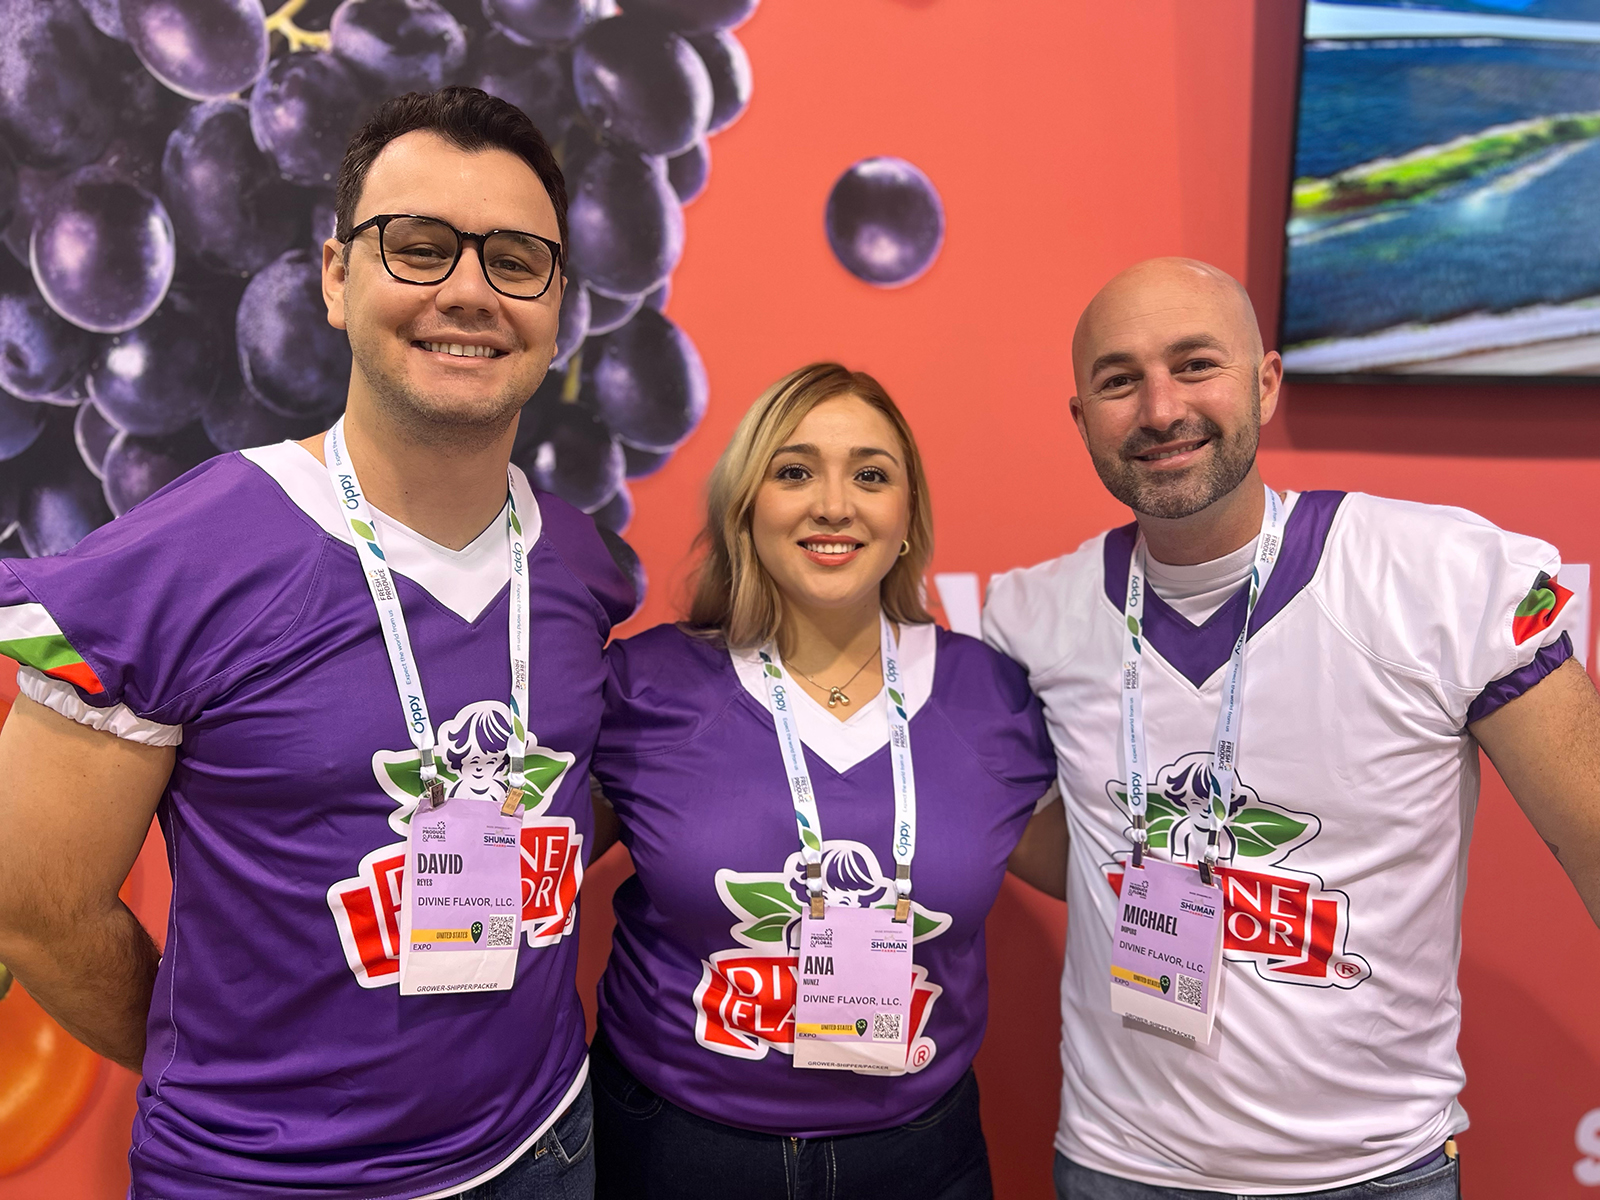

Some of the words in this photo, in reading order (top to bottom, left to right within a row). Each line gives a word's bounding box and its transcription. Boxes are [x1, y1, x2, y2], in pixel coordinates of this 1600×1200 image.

[338, 474, 361, 510] Oppy
[512, 542, 524, 576] Oppy
[1260, 534, 1272, 562] PRODUCE
[374, 578, 386, 601] FRESH
[378, 568, 393, 600] PRODUCE
[1129, 575, 1141, 607] Oppy
[388, 610, 393, 618] us
[394, 634, 402, 652] world
[402, 663, 411, 685] Expect
[886, 657, 899, 683] Oppy
[771, 685, 787, 712] Oppy
[408, 695, 426, 734] Oppy
[1218, 740, 1226, 771] PRODUCE
[1130, 772, 1144, 806] Oppy
[484, 836, 516, 844] SHUMAN
[896, 821, 912, 856] Oppy
[418, 853, 463, 874] DAVID
[417, 878, 433, 886] REYES
[1130, 884, 1148, 893] PRODUCE
[418, 897, 450, 906] DIVINE
[453, 898, 493, 908] FLAVOR,
[496, 898, 515, 906] LLC.
[1180, 902, 1215, 916] SHUMAN
[1122, 904, 1178, 936] MICHAEL
[871, 942, 908, 950] SHUMAN
[1120, 940, 1146, 956] DIVINE
[1148, 949, 1184, 968] FLAVOR,
[1186, 961, 1206, 974] LLC.
[804, 956, 834, 976] ANA
[1114, 977, 1130, 986] EXPO
[1133, 974, 1146, 984] UNITED
[1146, 979, 1160, 988] STATES
[803, 995, 835, 1004] DIVINE
[838, 996, 878, 1006] FLAVOR,
[882, 998, 902, 1006] LLC.
